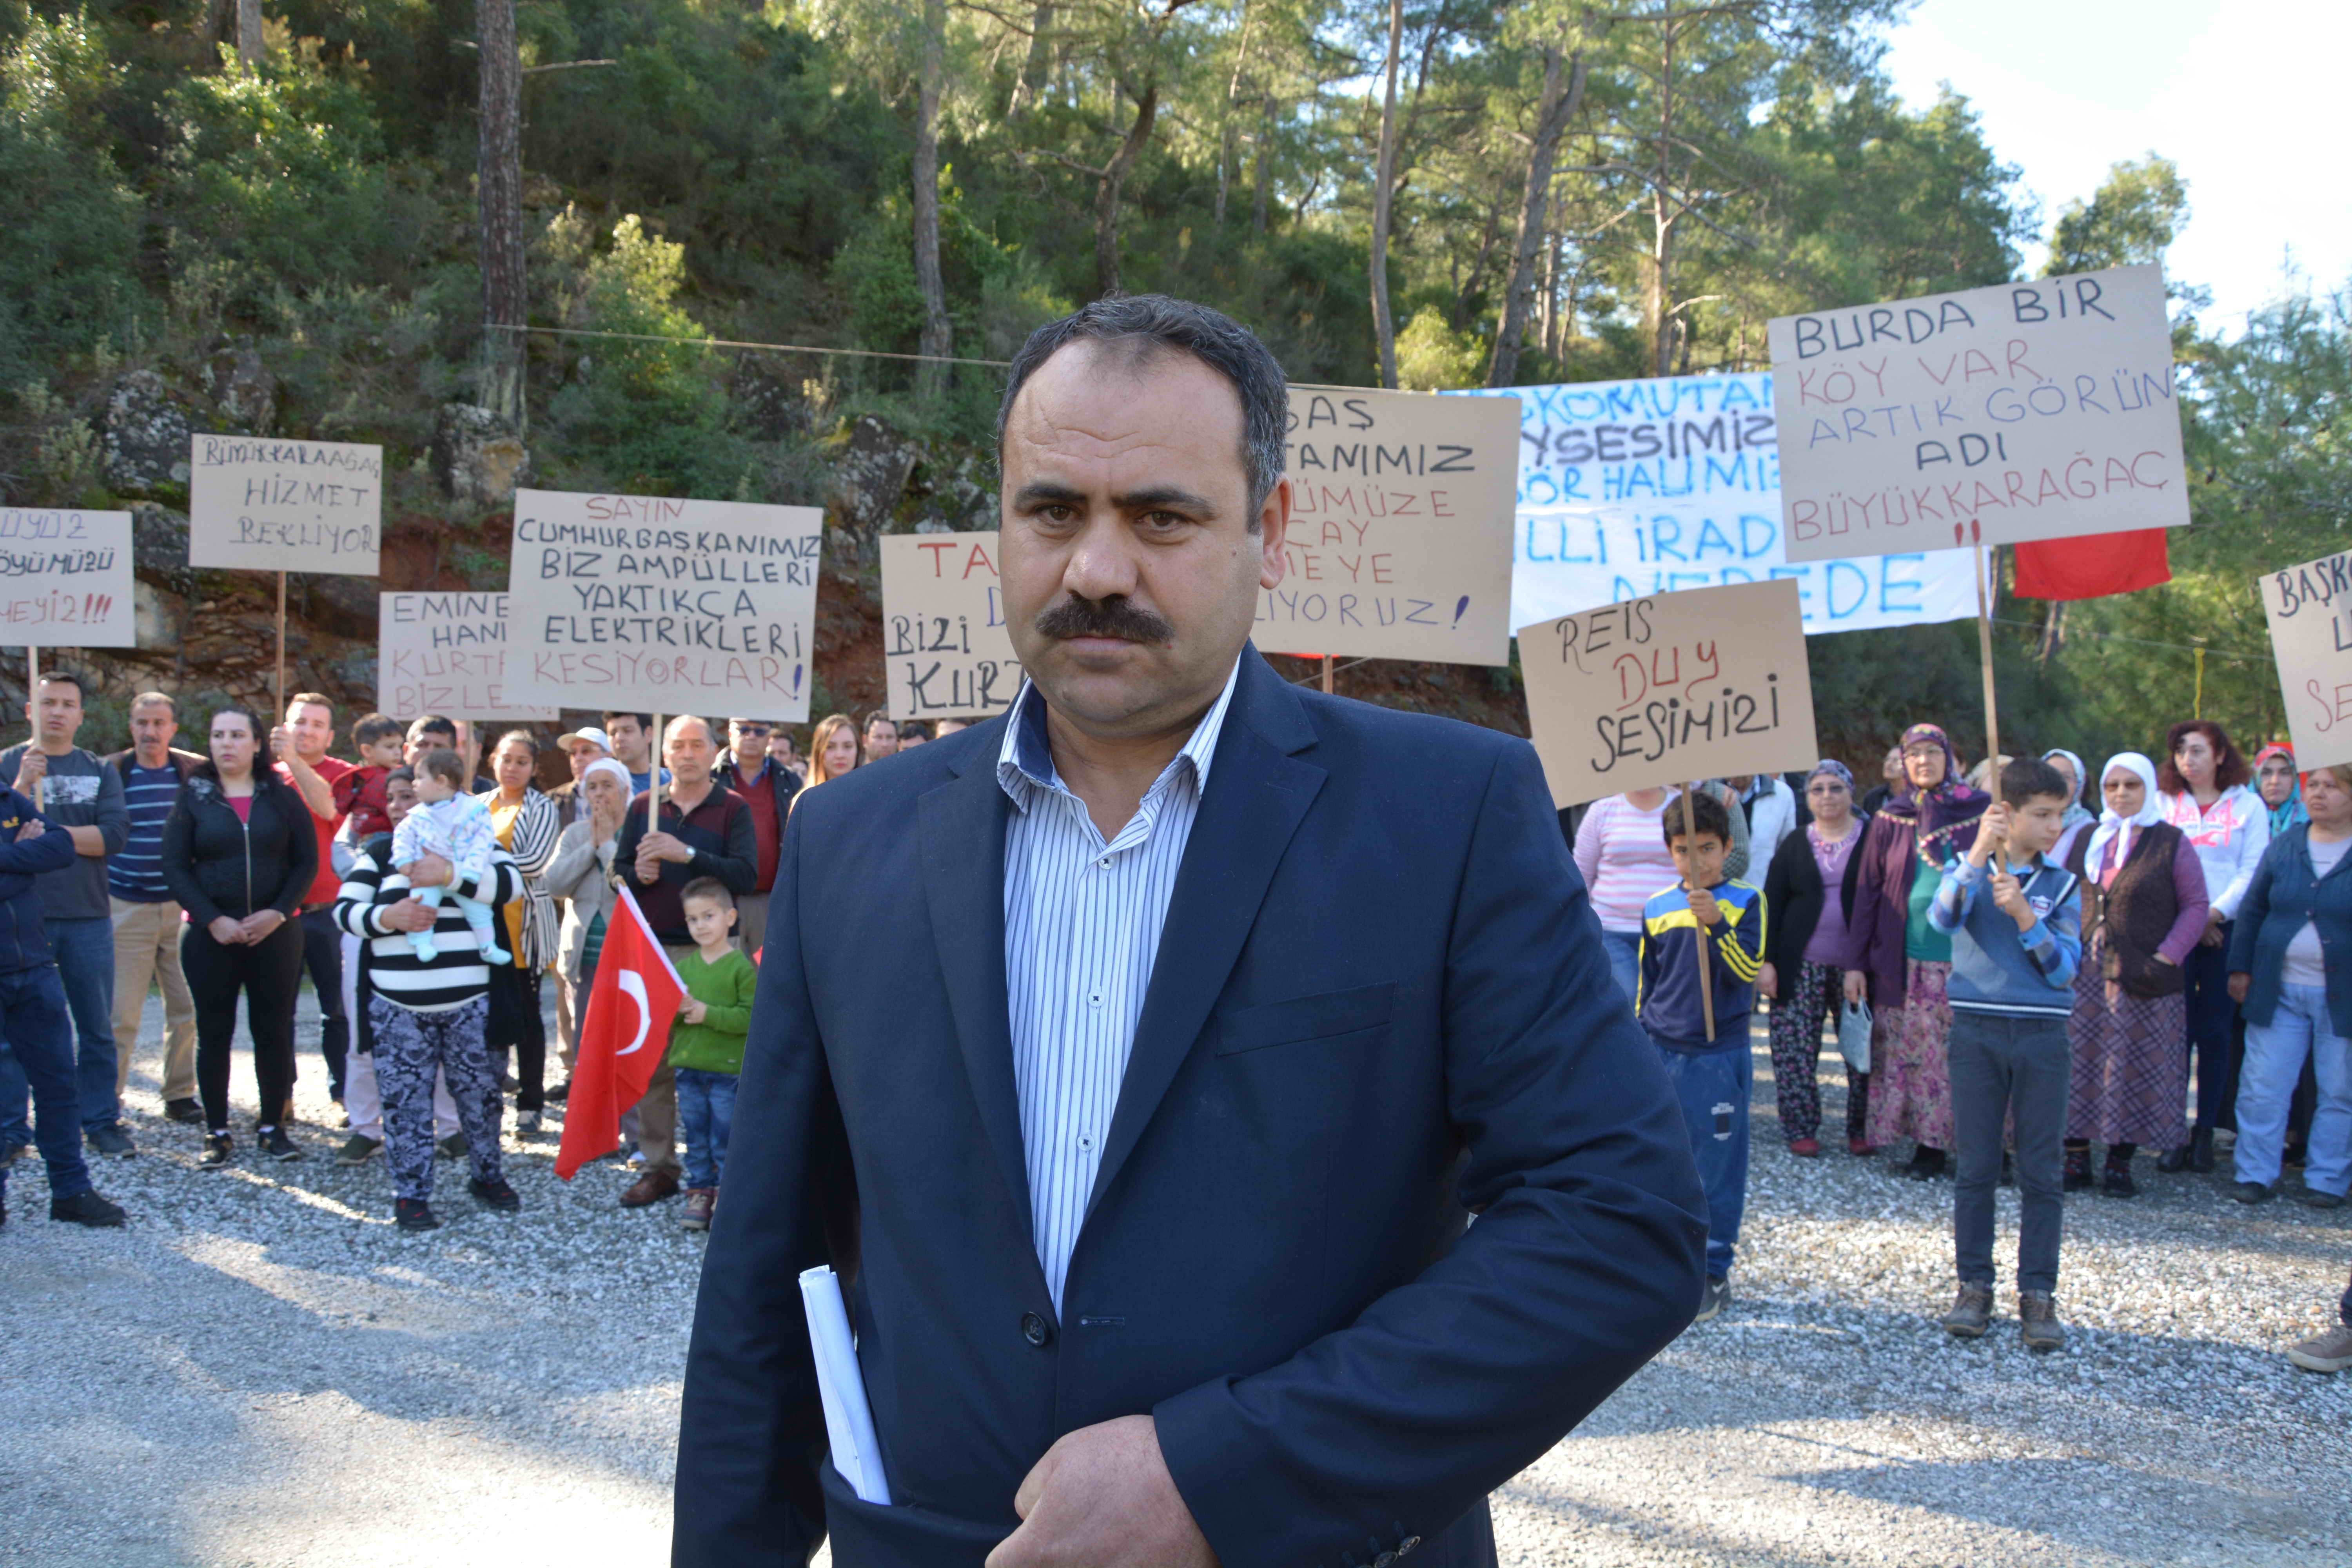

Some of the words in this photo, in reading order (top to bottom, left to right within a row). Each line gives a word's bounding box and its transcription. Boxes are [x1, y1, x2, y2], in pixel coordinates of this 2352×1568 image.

[1795, 301, 1975, 359] BURDA
[2012, 278, 2115, 324] BİR
[1798, 356, 1887, 406] KÖY
[1918, 339, 2044, 385] VAR
[1809, 396, 1964, 450] ARTIK
[1986, 367, 2170, 423] GÖRÜN
[1285, 443, 1475, 475] ANIMIZ
[1916, 432, 2008, 470] ADI
[245, 472, 369, 507] HİZMET
[1517, 465, 1590, 504] ÖR
[586, 496, 685, 522] SAYIN
[617, 552, 811, 586] AMPÜLLERİ
[394, 592, 509, 622] EMİNE
[573, 582, 757, 622] YAKTIKÇA
[544, 615, 801, 659] ELEKTRİKLERİ
[1613, 640, 1719, 711] DUY
